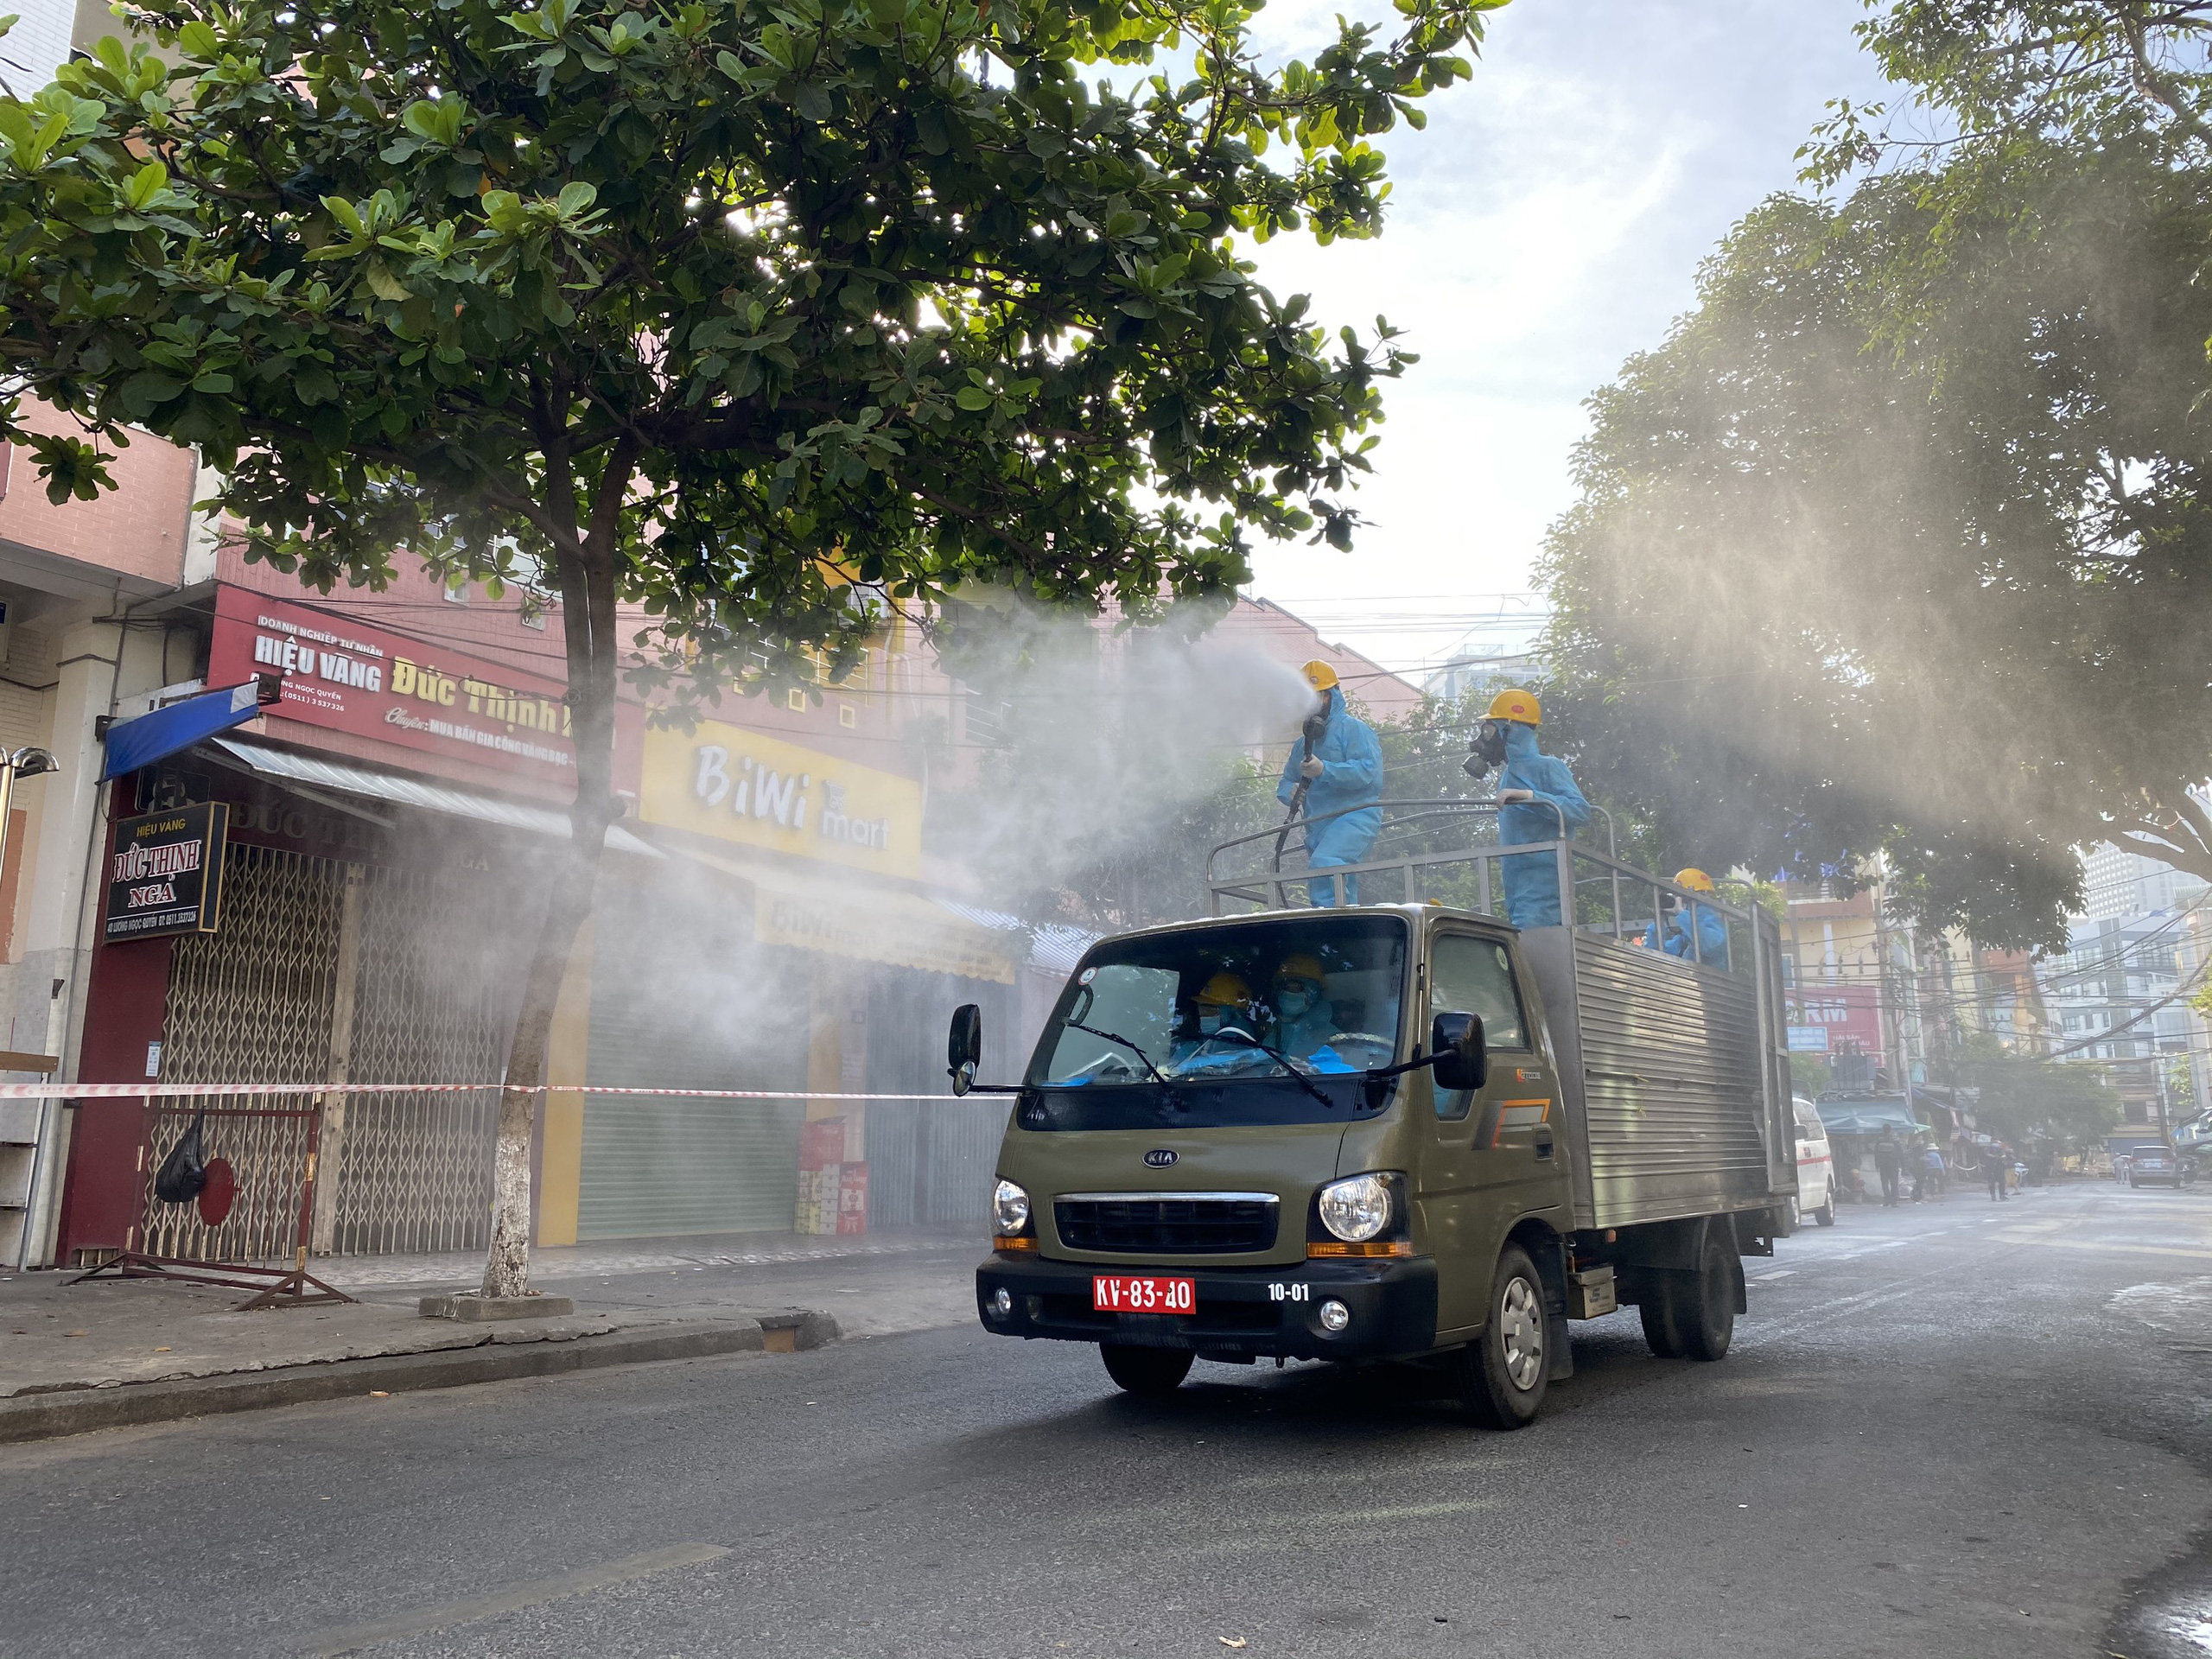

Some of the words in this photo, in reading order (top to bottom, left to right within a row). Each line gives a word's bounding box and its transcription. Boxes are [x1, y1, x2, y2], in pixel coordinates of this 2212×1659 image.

[258, 615, 297, 634] DOANH
[299, 626, 337, 646] NGHIỆP
[255, 635, 315, 677] HIỆU
[296, 683, 315, 695] NGỌC
[391, 656, 456, 707] Đức
[463, 679, 557, 734] Thịnh
[429, 719, 453, 737] MUA
[455, 725, 476, 743] BÁN
[695, 745, 810, 830] BiWi
[821, 810, 889, 850] mart
[137, 823, 157, 837] HIỆU
[159, 818, 186, 832] VÀNG
[112, 842, 147, 883] ĐỨC
[148, 839, 201, 880] THỊNH
[128, 883, 176, 908] NGA
[1148, 1152, 1173, 1163] KIA
[1096, 1279, 1191, 1308] KV-83-40
[1268, 1283, 1309, 1301] 10-01
